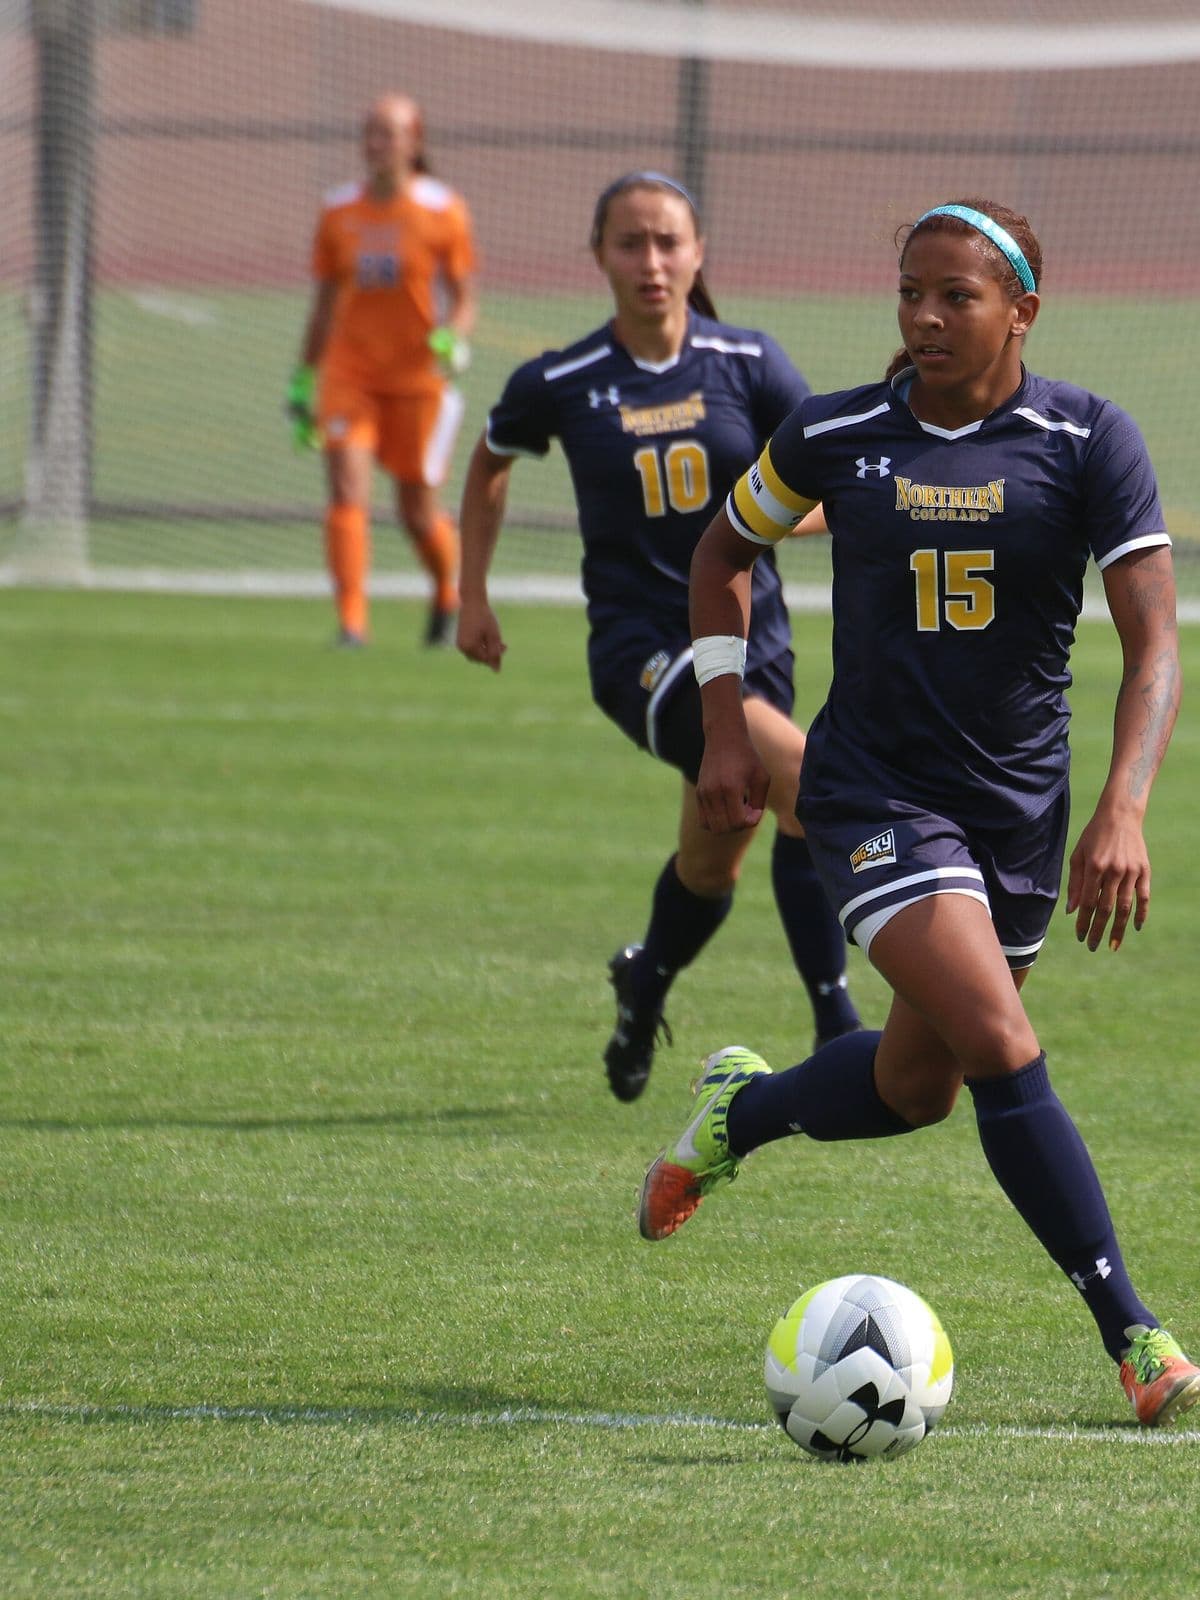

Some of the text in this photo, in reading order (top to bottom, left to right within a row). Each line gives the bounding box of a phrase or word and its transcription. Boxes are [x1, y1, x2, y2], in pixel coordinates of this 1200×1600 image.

[634, 441, 711, 518] 10
[750, 464, 763, 495] TAIN
[894, 475, 1005, 513] NORTHERN
[910, 508, 990, 522] COLORADO
[910, 549, 996, 631] 15
